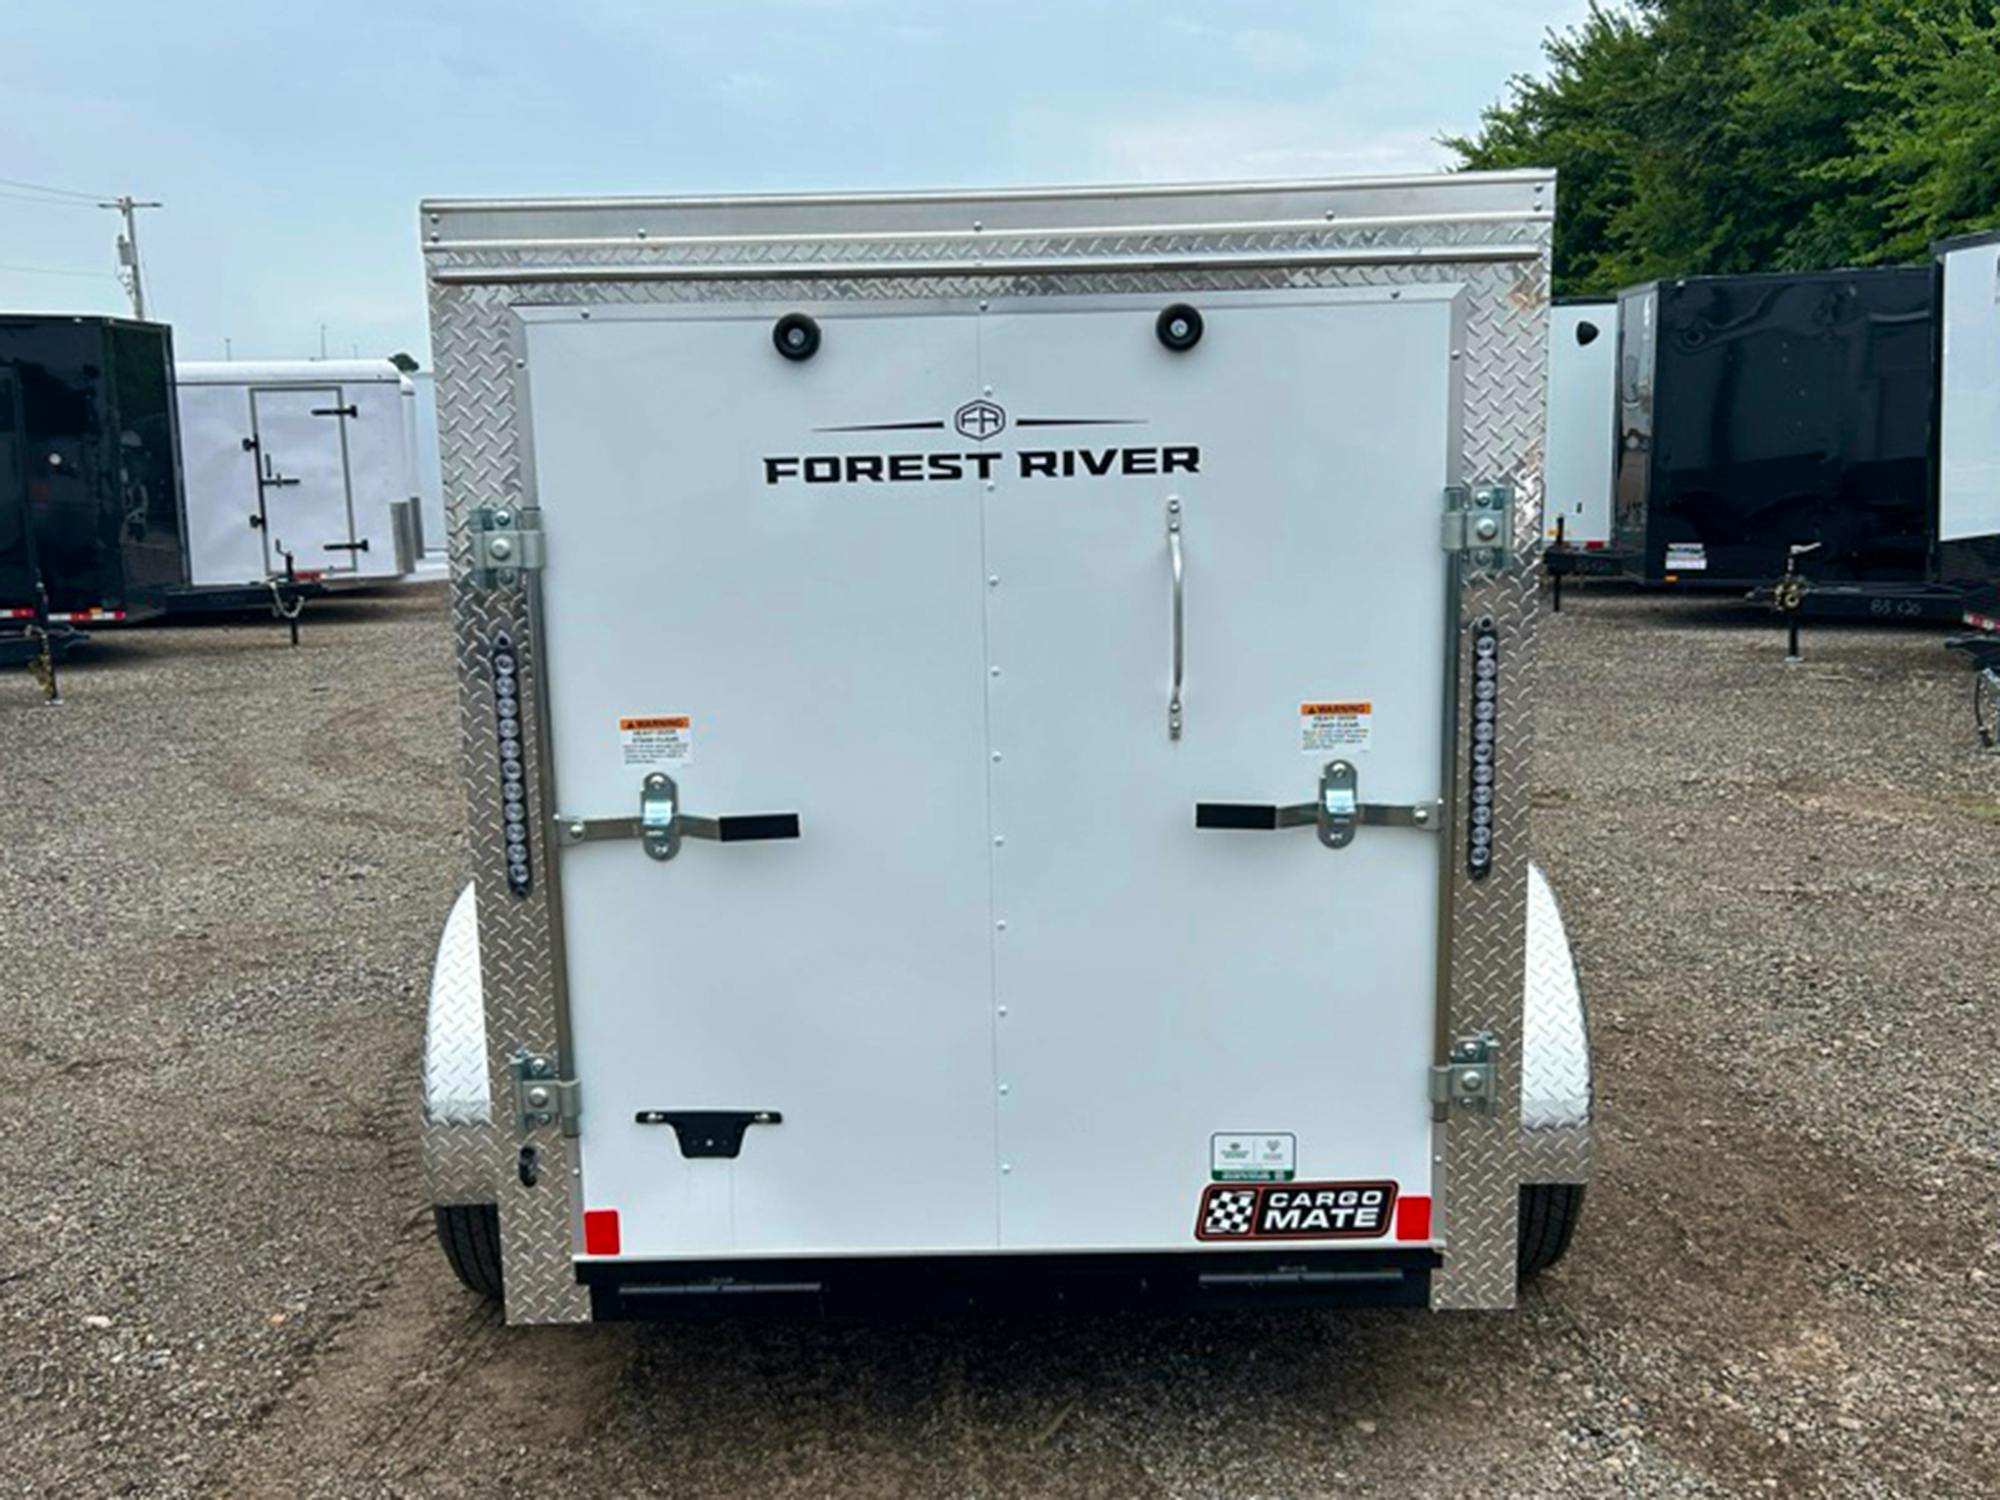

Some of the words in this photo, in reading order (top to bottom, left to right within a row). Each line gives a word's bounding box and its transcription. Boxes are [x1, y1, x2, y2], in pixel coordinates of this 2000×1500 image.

[763, 453, 1002, 484] FOREST
[1018, 447, 1200, 478] RIVER
[1318, 704, 1364, 714] WARNING
[1269, 1190, 1382, 1207] CARGO
[1264, 1208, 1379, 1230] MATE
